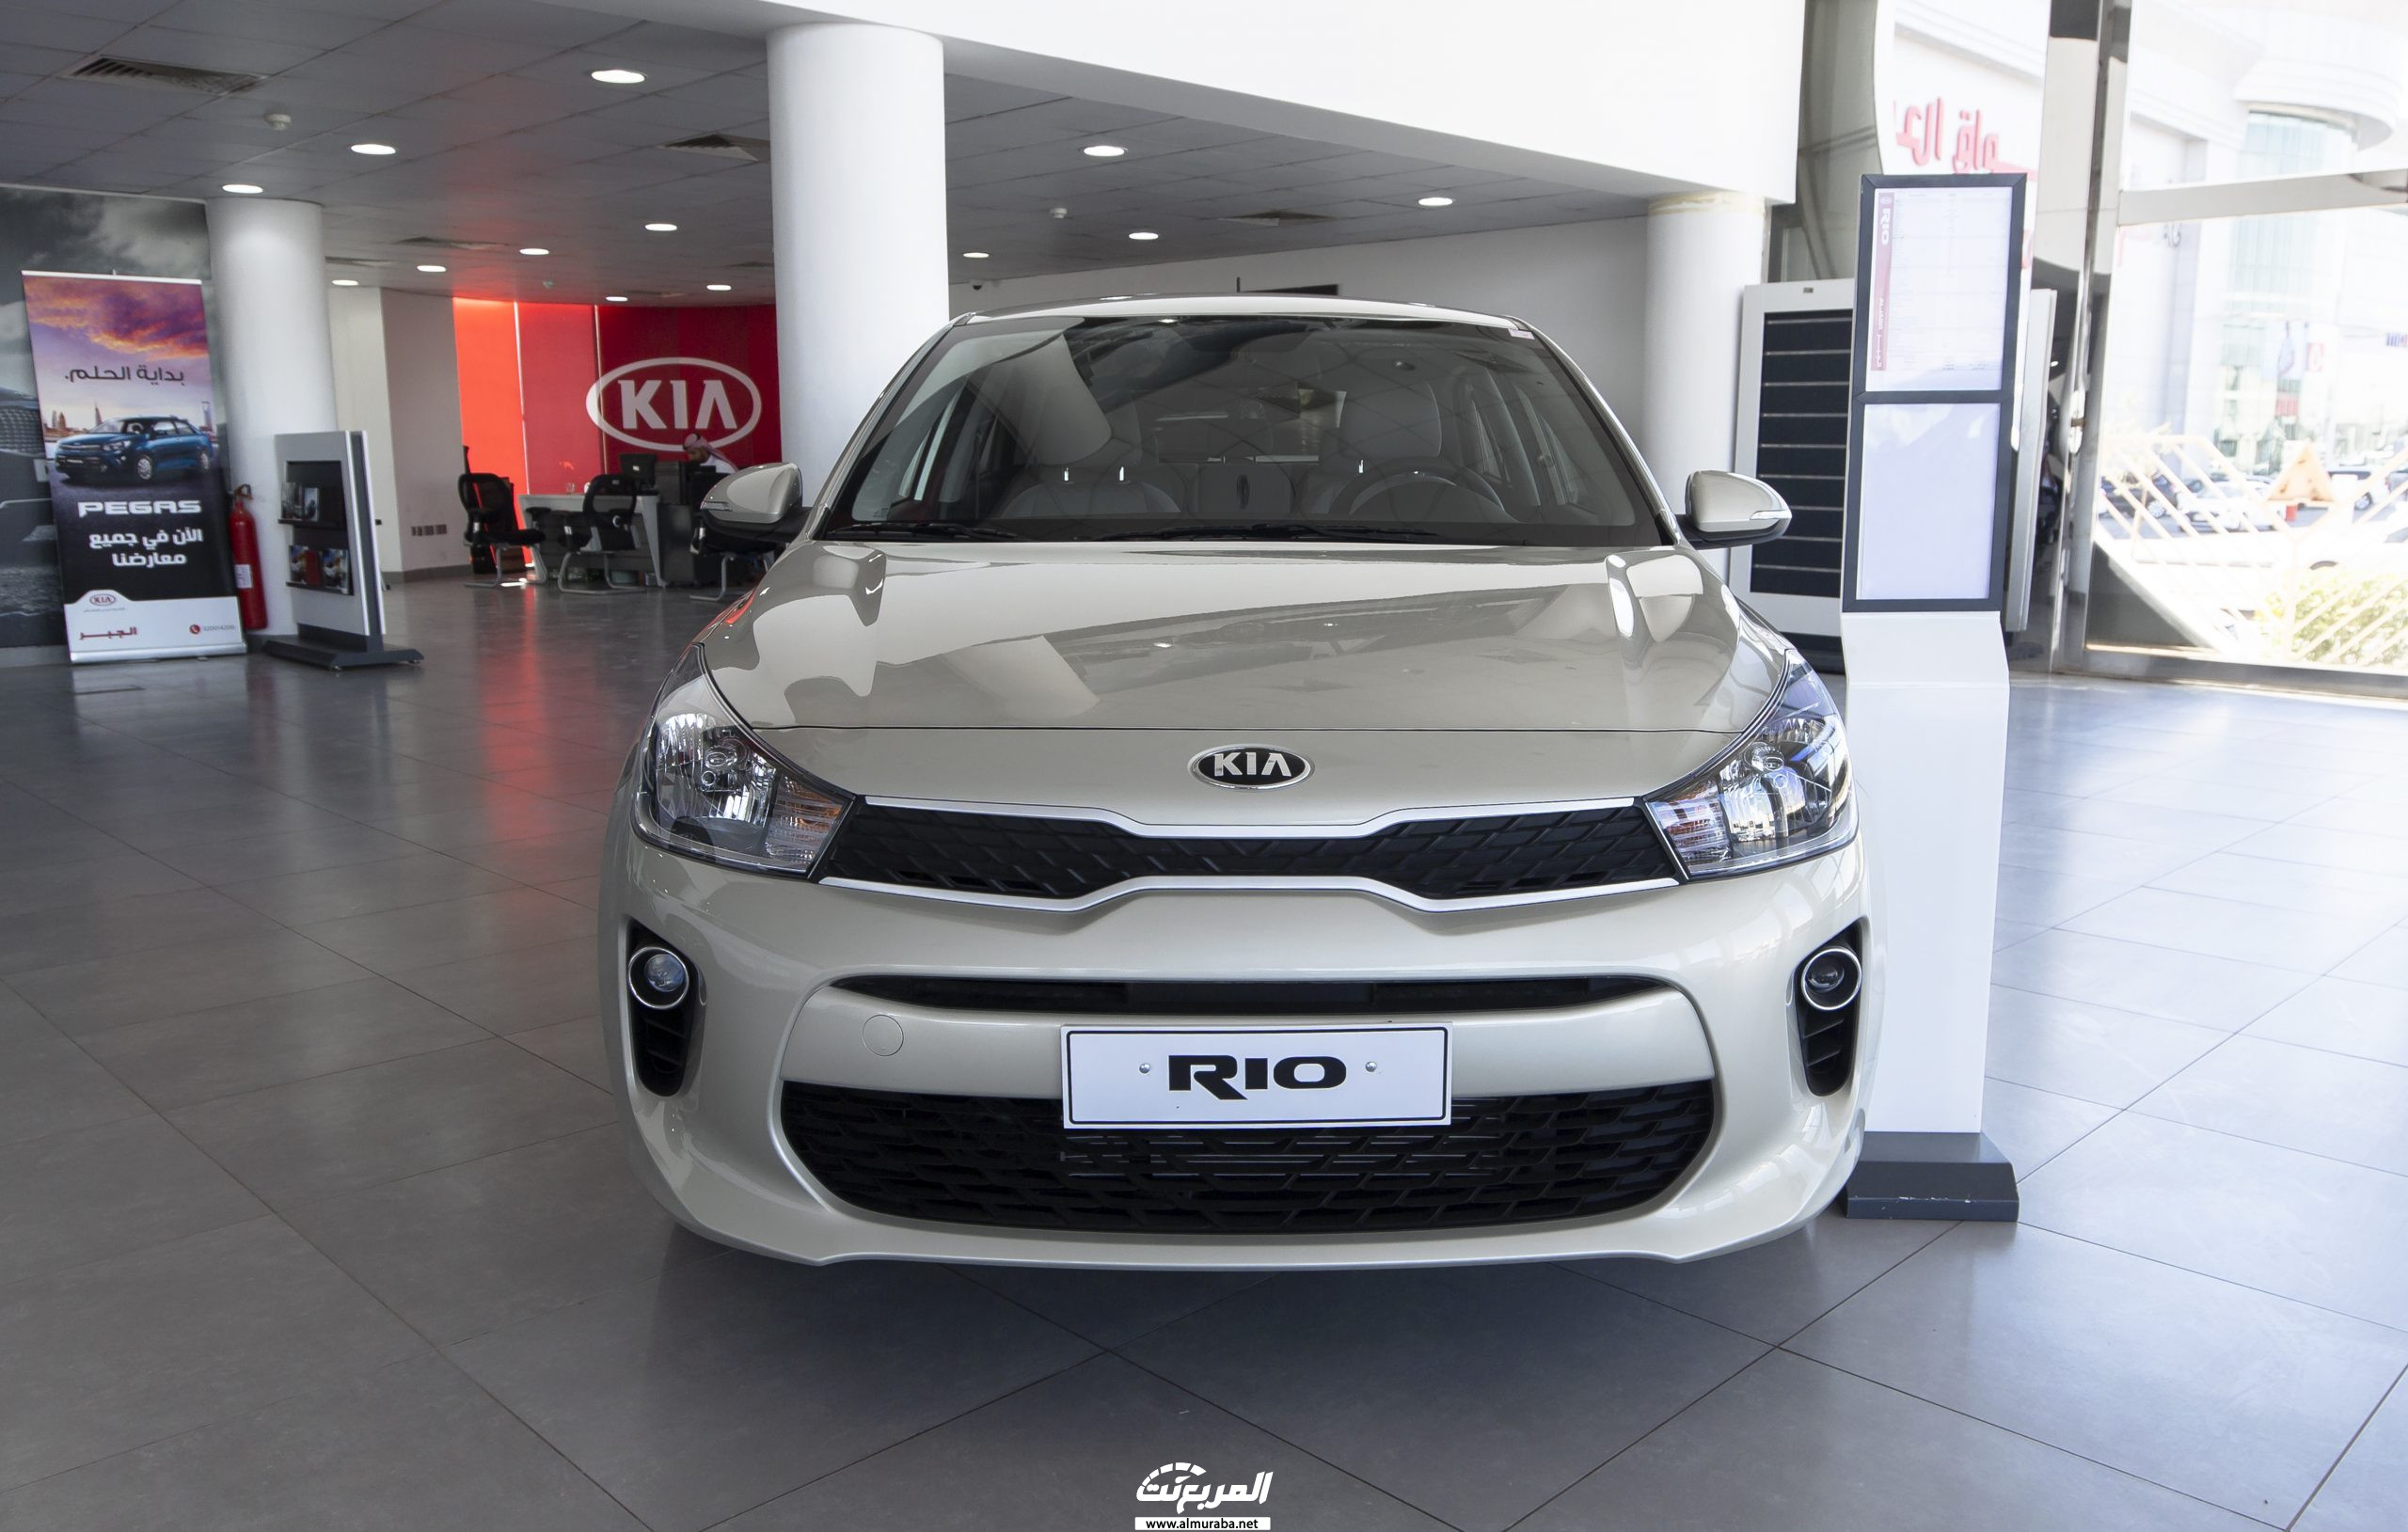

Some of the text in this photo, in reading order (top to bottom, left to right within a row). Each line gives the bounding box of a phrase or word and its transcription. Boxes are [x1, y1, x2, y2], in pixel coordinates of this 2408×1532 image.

[1880, 208, 1890, 245] RIO
[65, 365, 185, 386] بداية الحلم.
[617, 379, 737, 430] KIA
[77, 500, 202, 518] PEGAS
[89, 532, 138, 549] جميع
[142, 529, 169, 550] في
[112, 552, 187, 568] معارضنا
[1213, 752, 1291, 777] KIA
[1168, 1054, 1347, 1100] RIO
